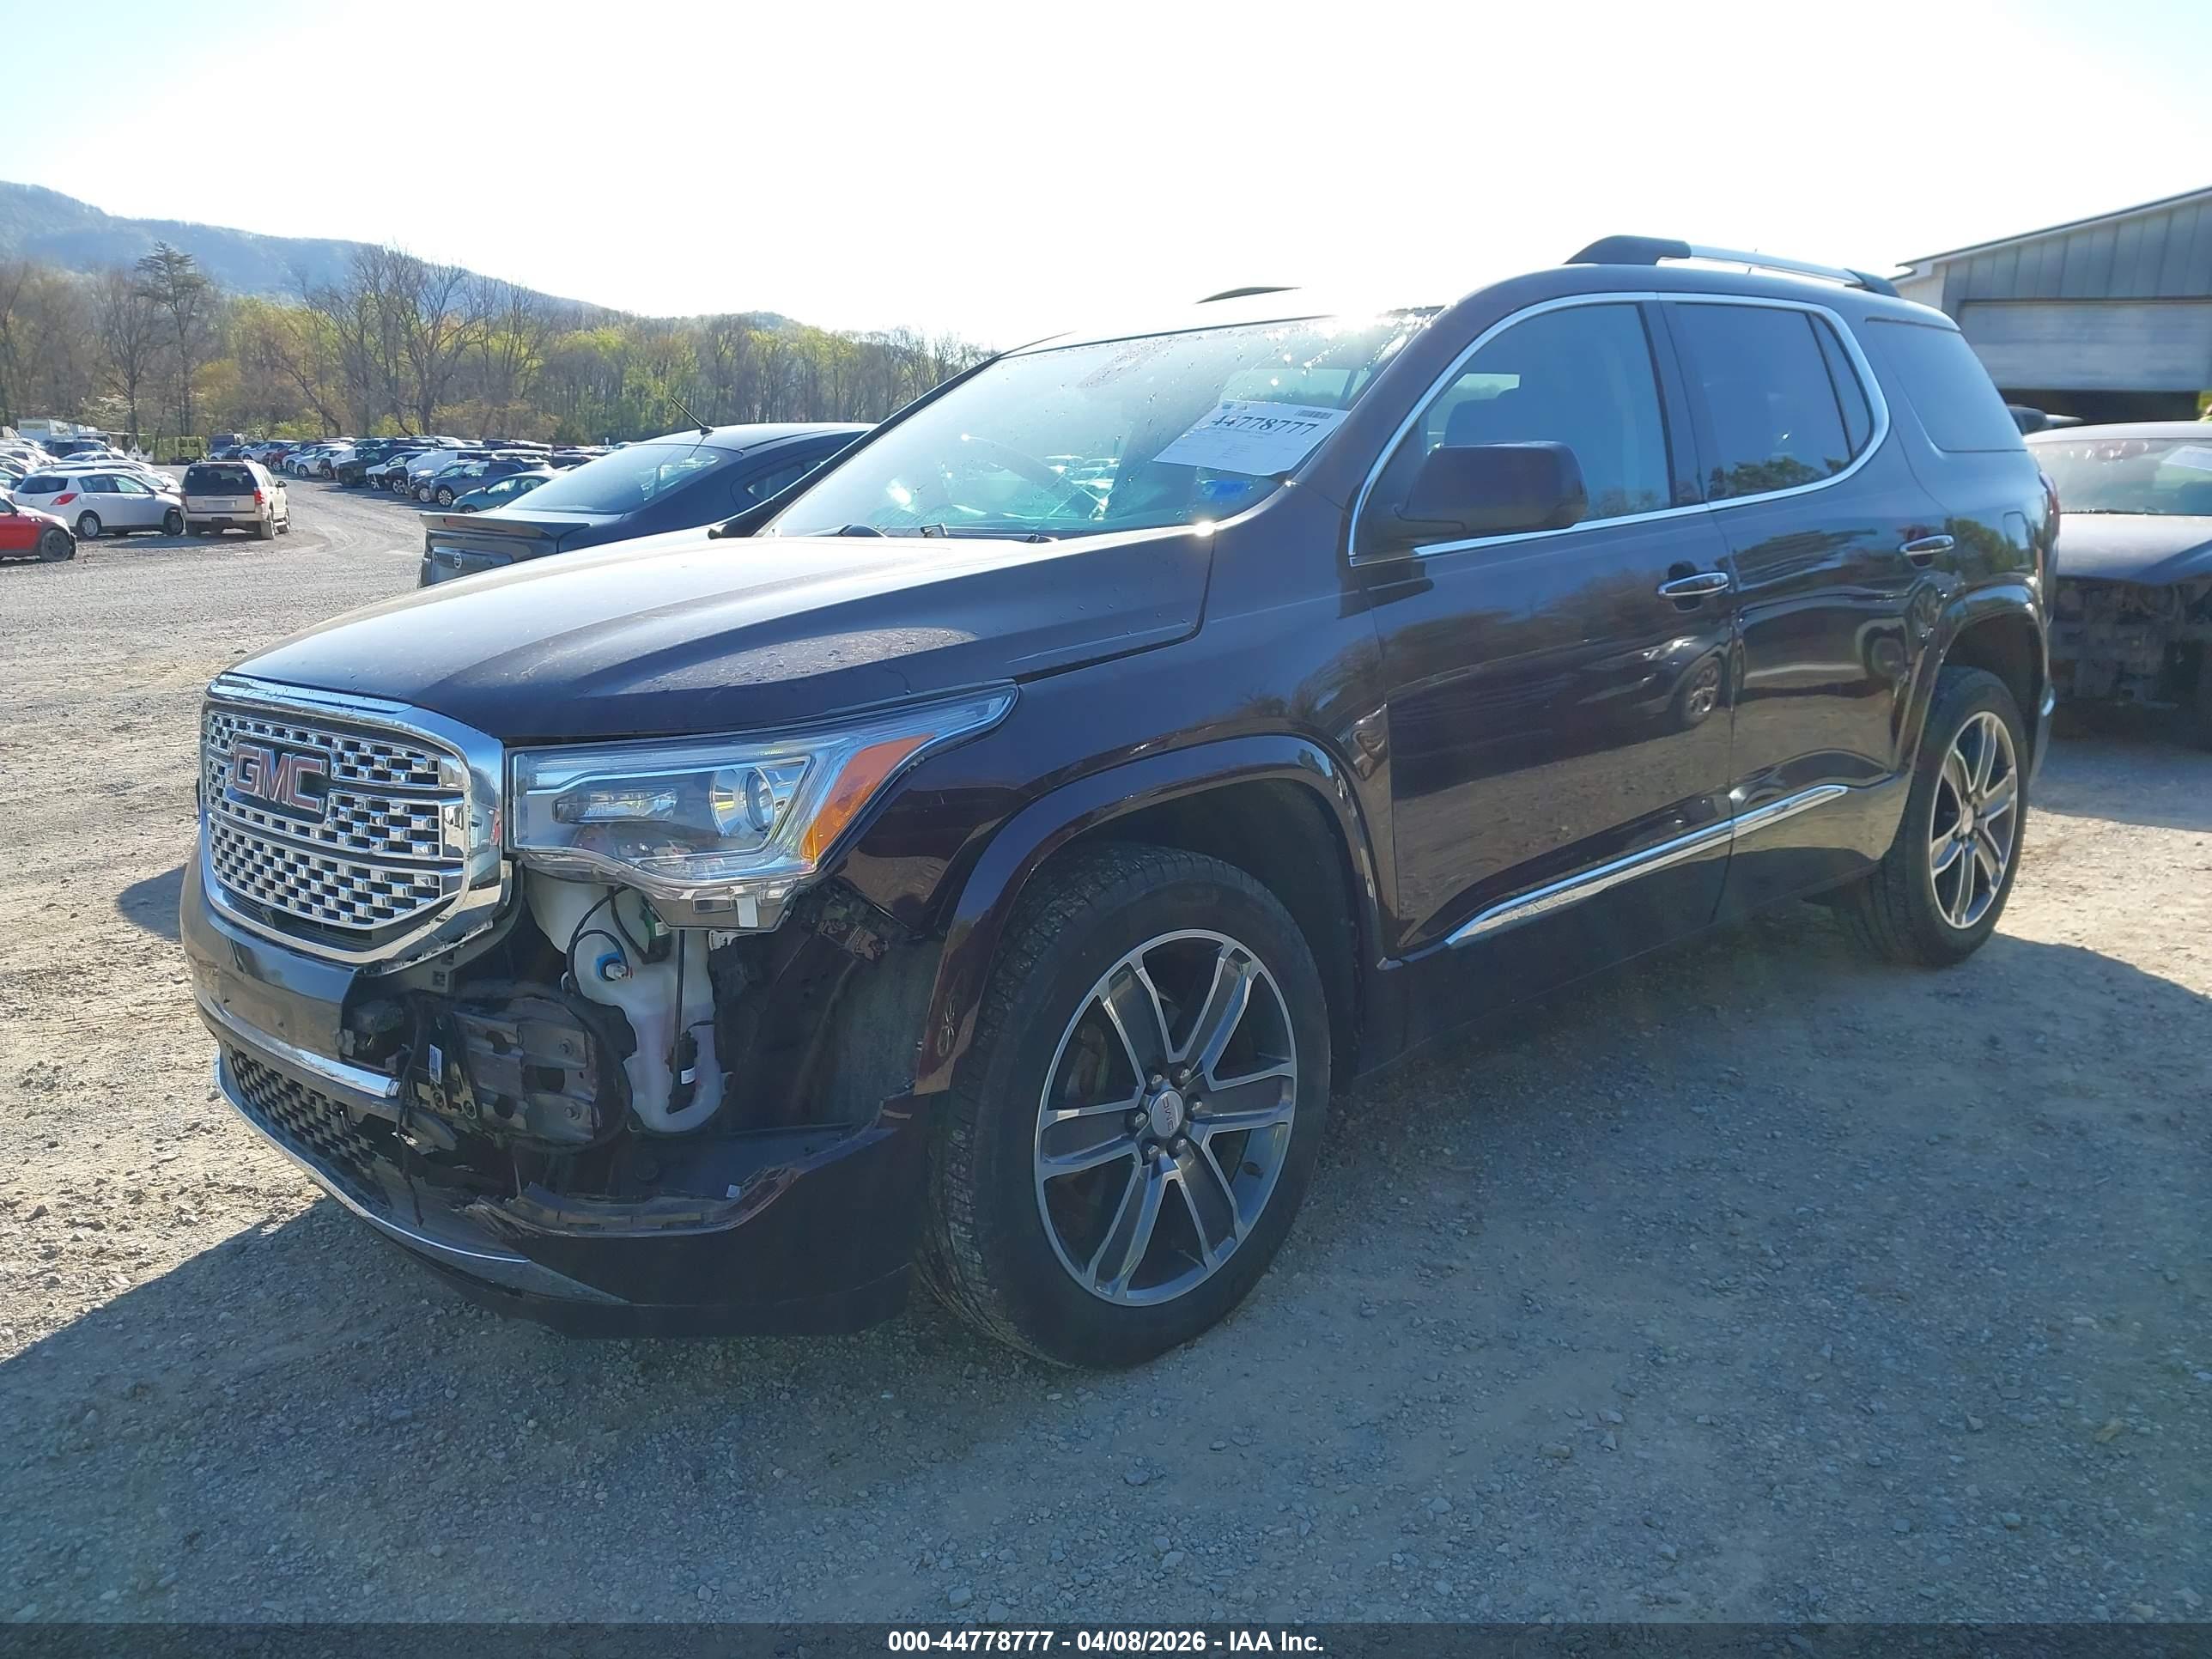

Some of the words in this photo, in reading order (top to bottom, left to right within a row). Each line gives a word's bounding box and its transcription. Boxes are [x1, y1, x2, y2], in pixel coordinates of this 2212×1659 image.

[1212, 415, 1319, 435] 44778777
[233, 743, 326, 814] GMC
[1162, 1097, 1174, 1131] GMC
